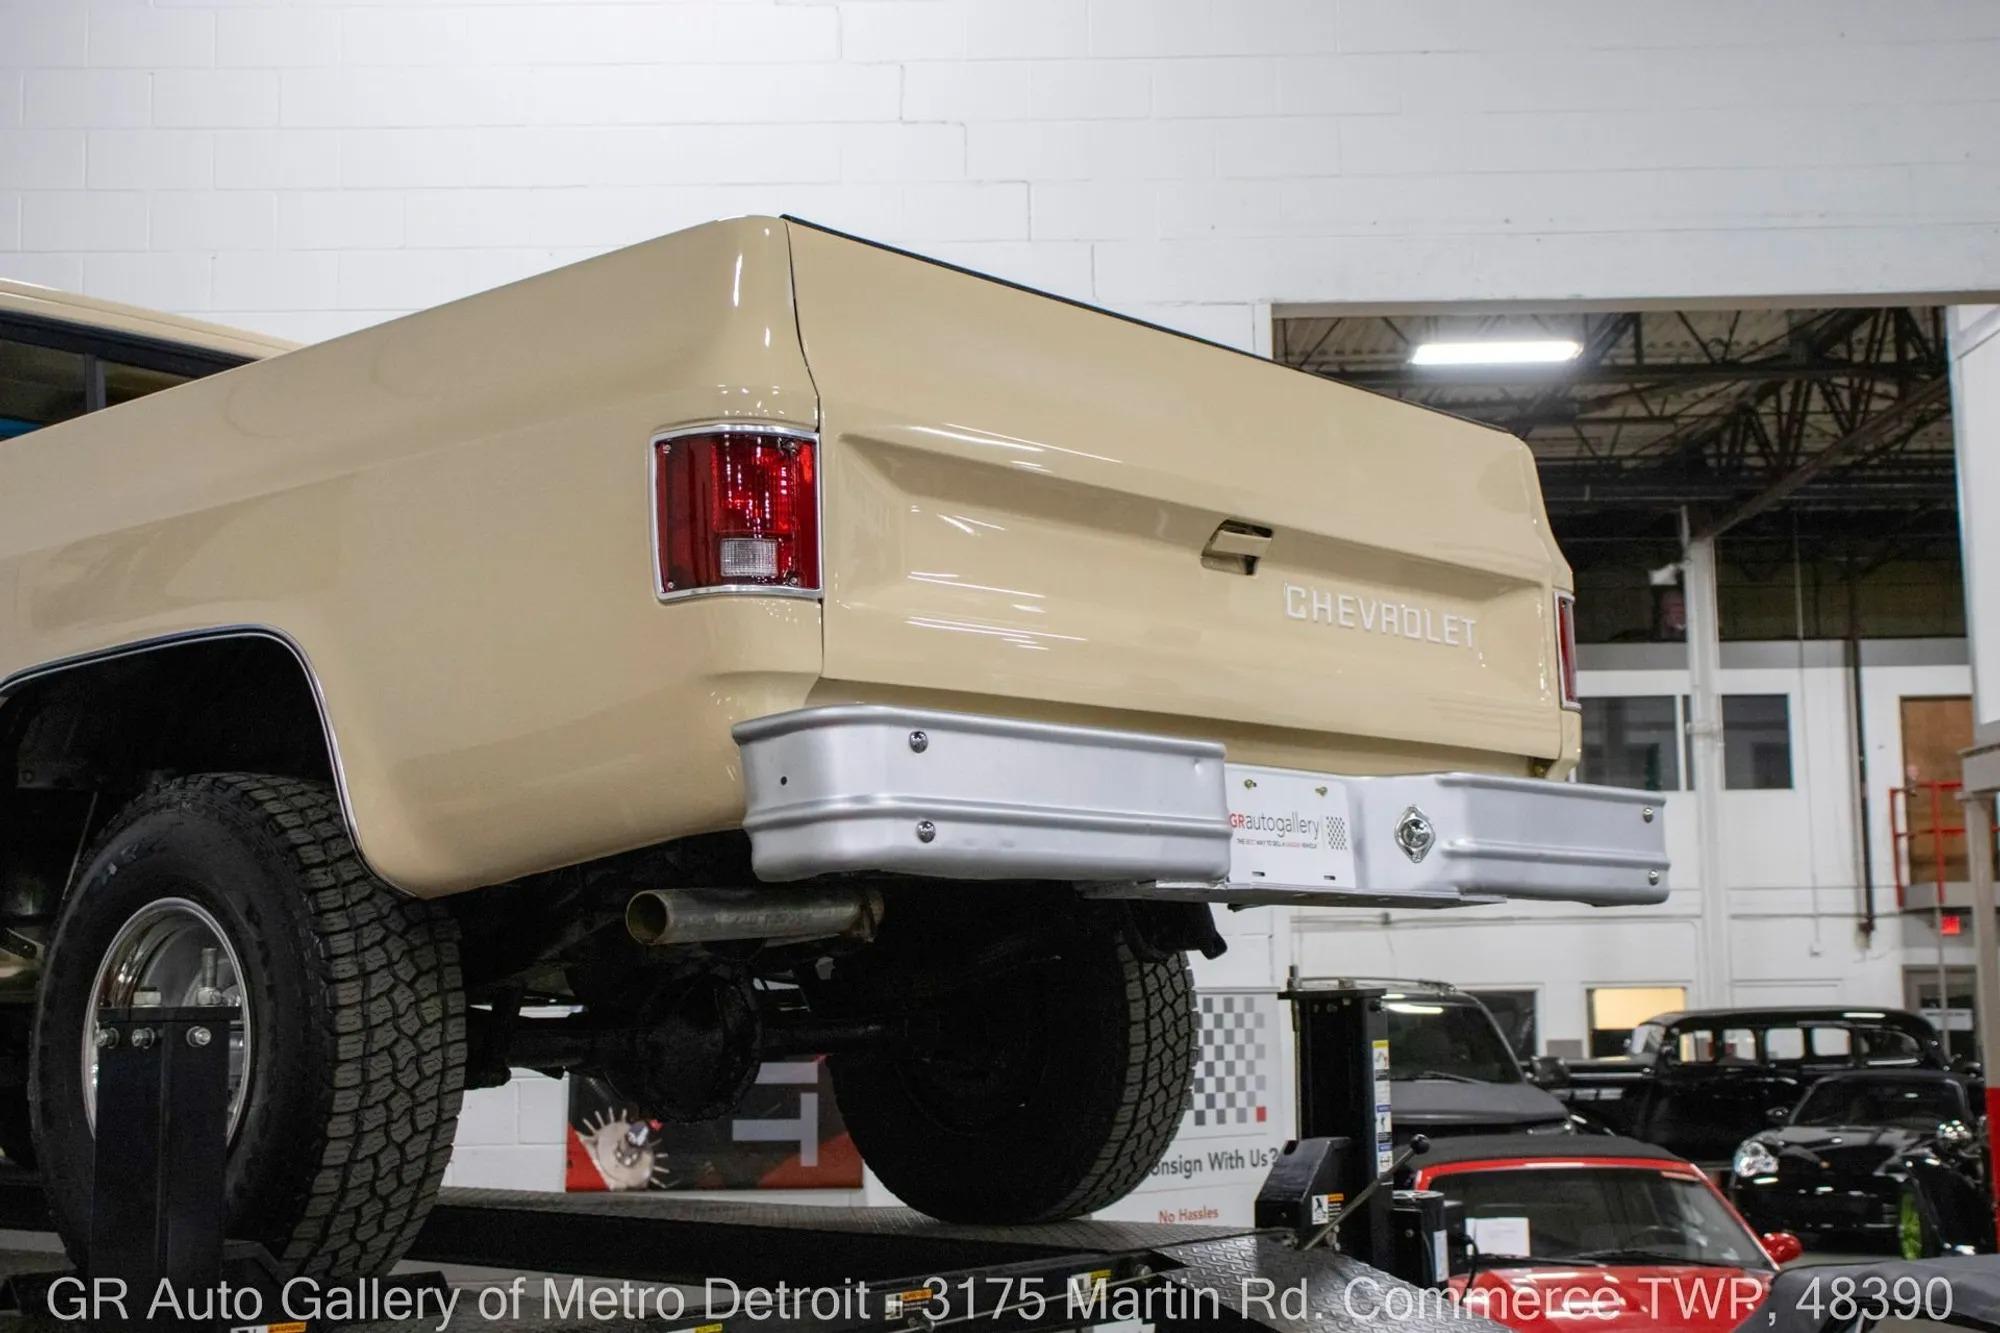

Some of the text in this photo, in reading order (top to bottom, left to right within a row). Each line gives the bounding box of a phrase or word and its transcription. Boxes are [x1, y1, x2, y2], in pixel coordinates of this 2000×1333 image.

[1284, 583, 1477, 648] CHEVROLET
[1229, 811, 1320, 841] GRautogallery
[1150, 1146, 1279, 1180] onsign With Us?
[1159, 1204, 1219, 1225] No Hassles
